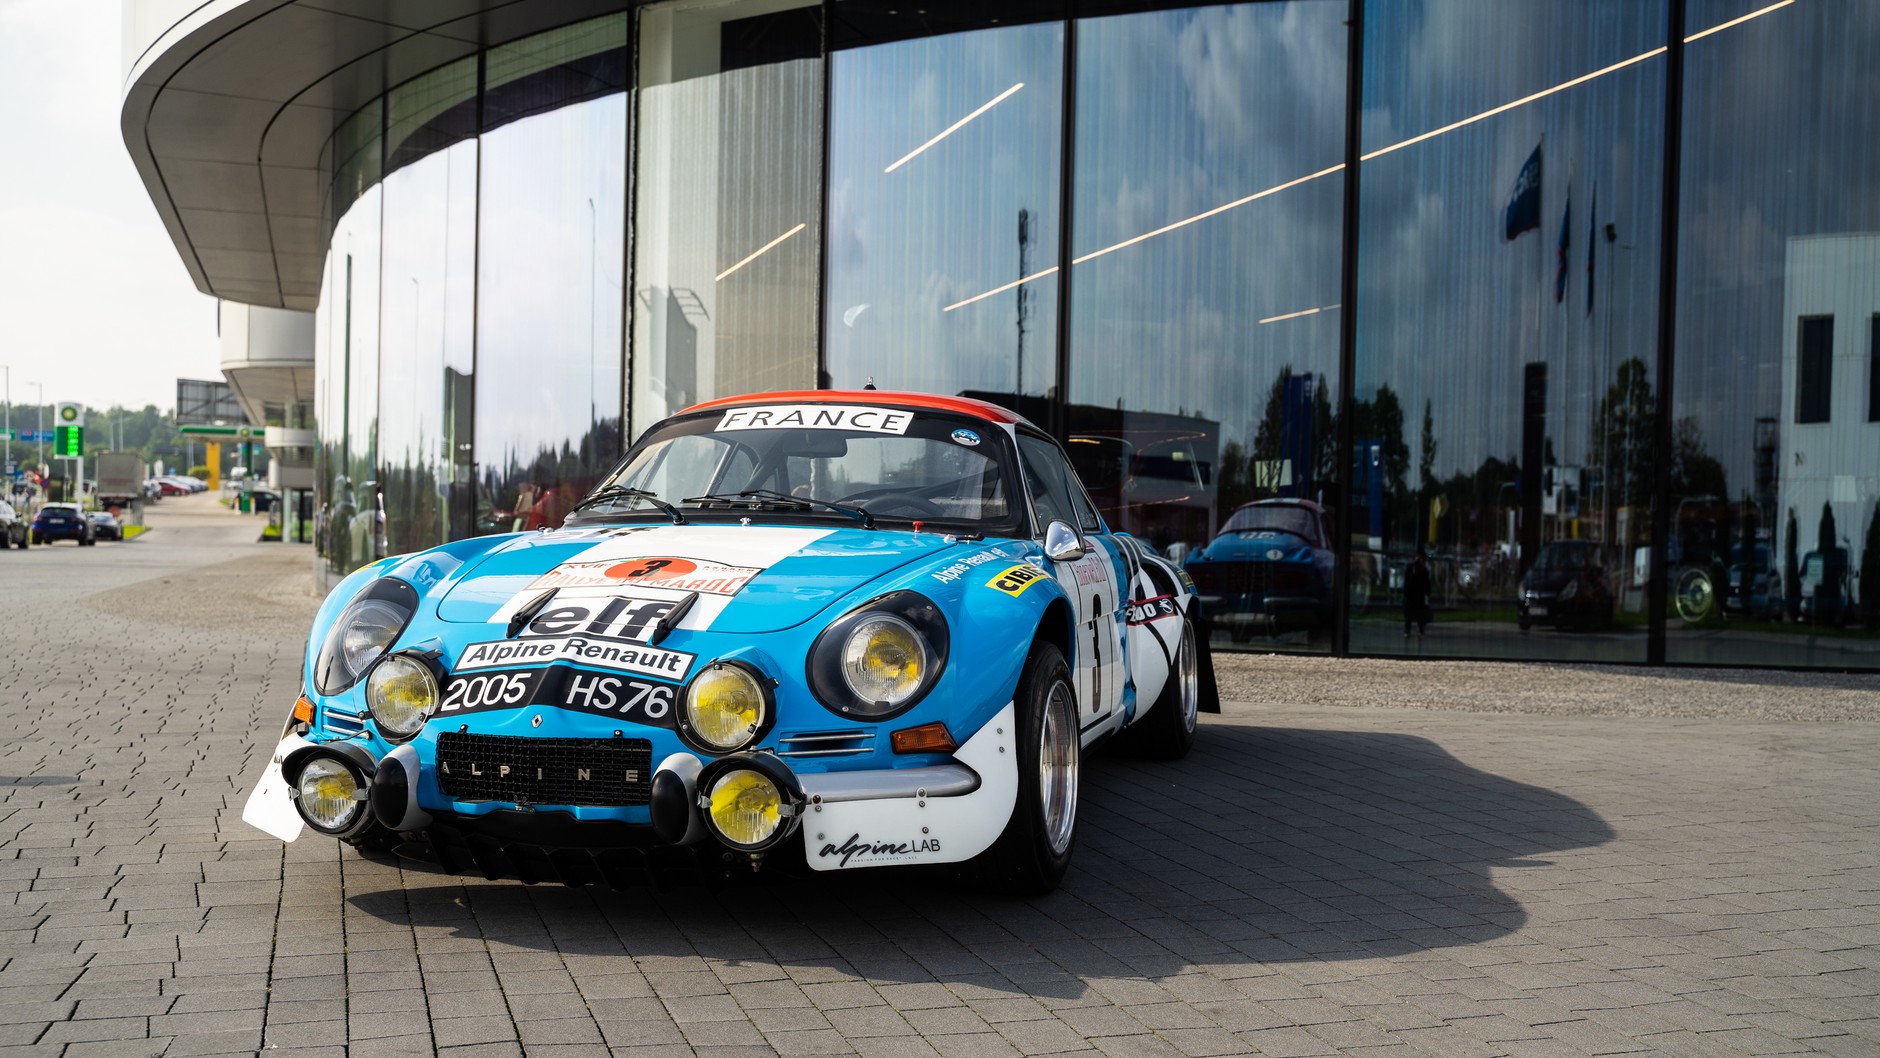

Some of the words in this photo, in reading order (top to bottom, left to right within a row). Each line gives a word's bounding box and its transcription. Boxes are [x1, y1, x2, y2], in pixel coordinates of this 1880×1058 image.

[723, 410, 905, 431] FRANCE
[628, 560, 673, 577] 3
[931, 563, 970, 584] Alpine
[534, 571, 607, 587] RALLYE
[649, 576, 748, 593] MAROC
[529, 597, 678, 639] elf
[467, 642, 556, 664] Alpine
[561, 638, 682, 672] Renault
[440, 672, 532, 712] 2005
[440, 761, 639, 782] ALPINE
